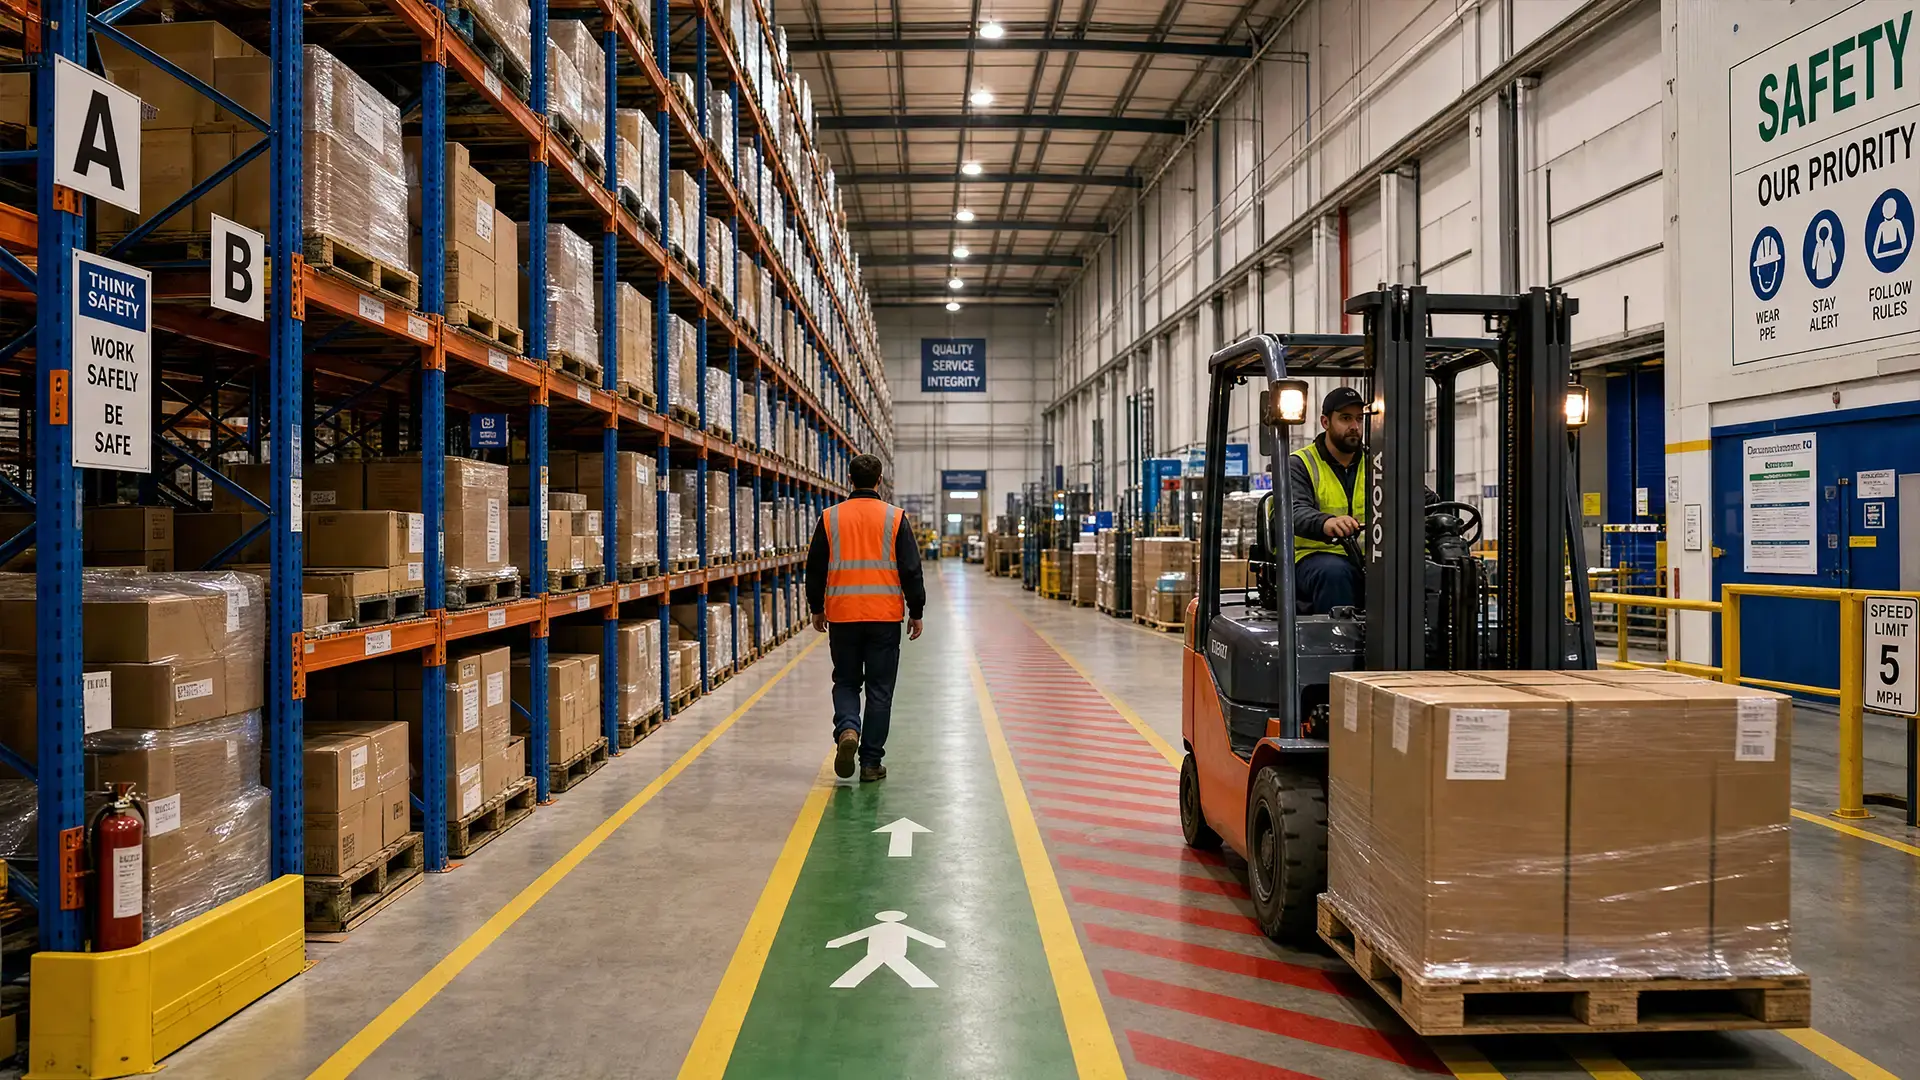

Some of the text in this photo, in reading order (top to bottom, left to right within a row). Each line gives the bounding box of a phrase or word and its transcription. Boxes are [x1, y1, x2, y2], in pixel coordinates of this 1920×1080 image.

[1758, 10, 1913, 142] SAFETY
[73, 89, 125, 191] A
[1758, 122, 1916, 207] OUR PRIORITY
[225, 231, 252, 303] B
[89, 271, 135, 299] THINK
[1869, 280, 1912, 302] FOLLOW
[88, 290, 140, 319] SAFETY
[1812, 296, 1836, 313] STAY
[1873, 300, 1907, 320] RULES
[1756, 308, 1780, 324] WEAR
[1809, 313, 1839, 332] ALERT
[1759, 326, 1776, 341] PPE
[91, 335, 135, 363] WORK
[932, 344, 973, 356] QUALITY
[932, 360, 974, 371] SERVICE
[87, 364, 138, 392] SAFELY
[928, 376, 980, 387] INTEGRITY
[105, 403, 123, 426] BE
[95, 431, 131, 456] SAFE
[1372, 451, 1382, 563] TOYOTA
[1870, 604, 1913, 619] SPEED
[1875, 622, 1908, 637] LIMIT
[1880, 644, 1899, 685] 5
[1877, 690, 1902, 705] MPH
